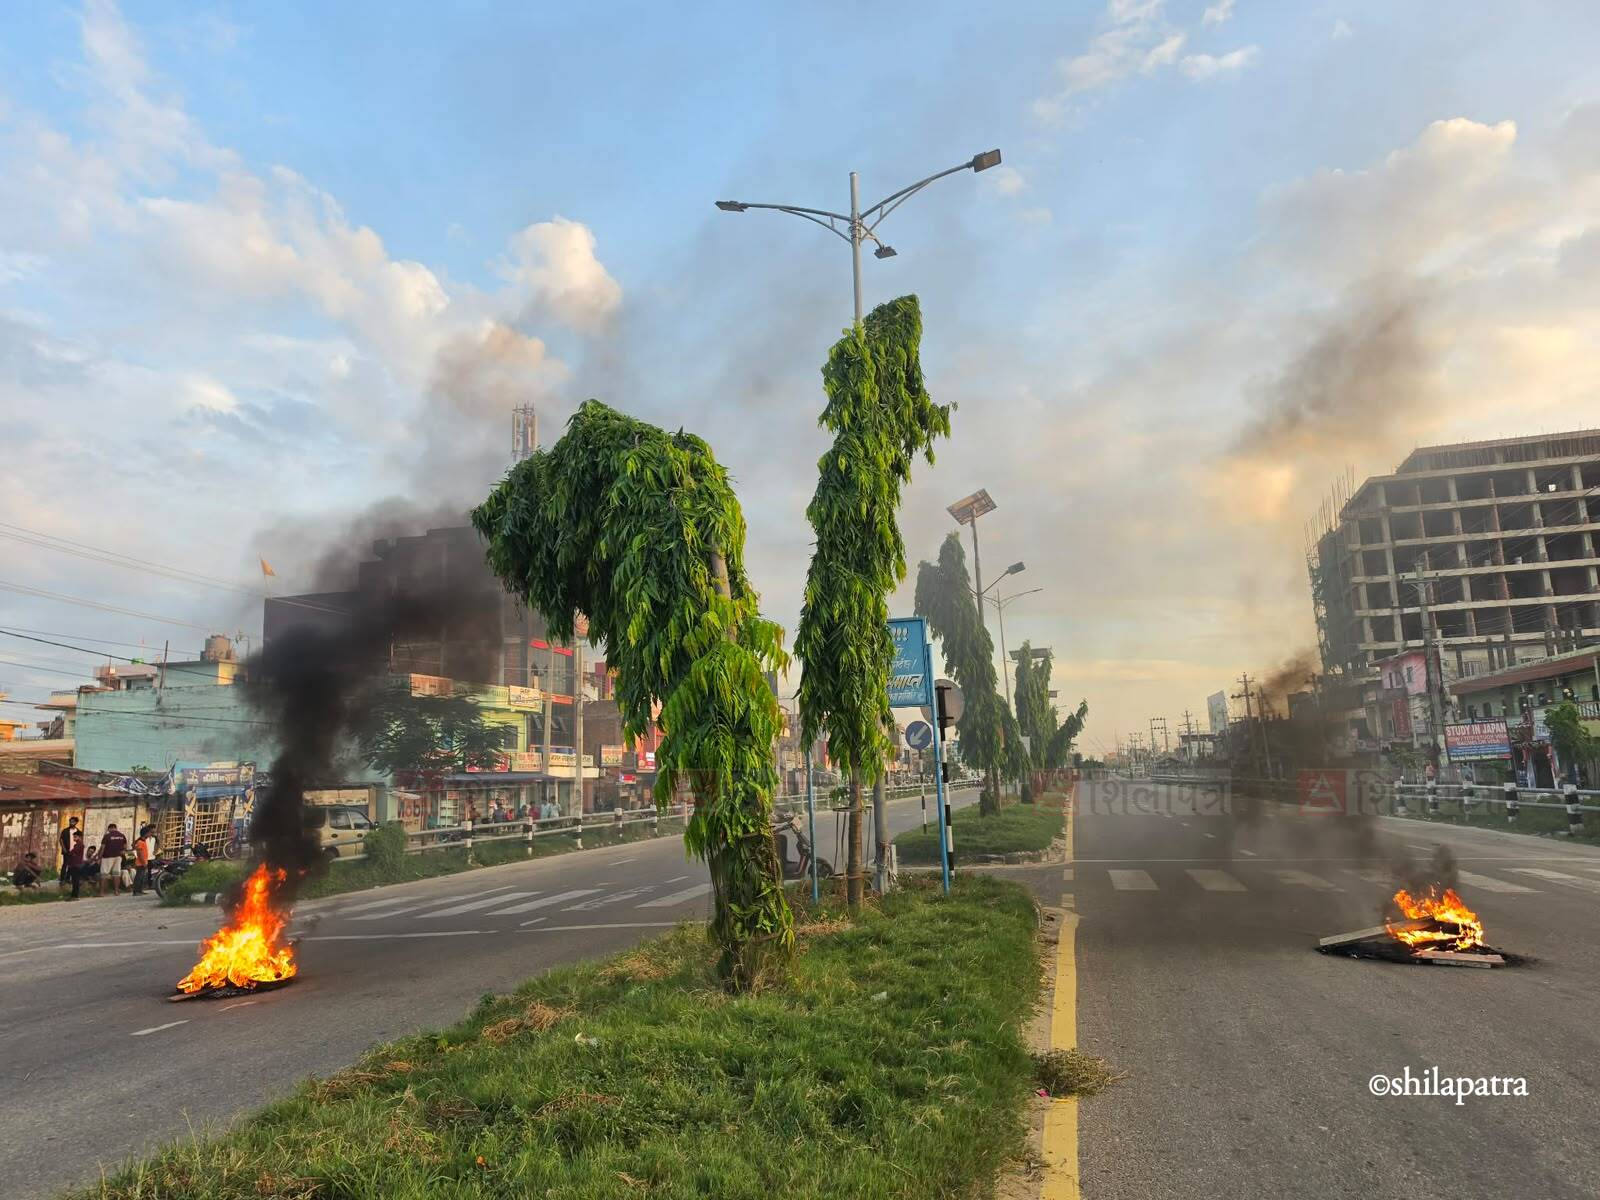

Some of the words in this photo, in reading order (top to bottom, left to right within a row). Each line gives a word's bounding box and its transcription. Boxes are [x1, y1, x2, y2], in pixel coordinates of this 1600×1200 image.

[1445, 724, 1471, 736] STUDY
[1471, 723, 1481, 735] IN
[1482, 721, 1507, 734] JAPAN
